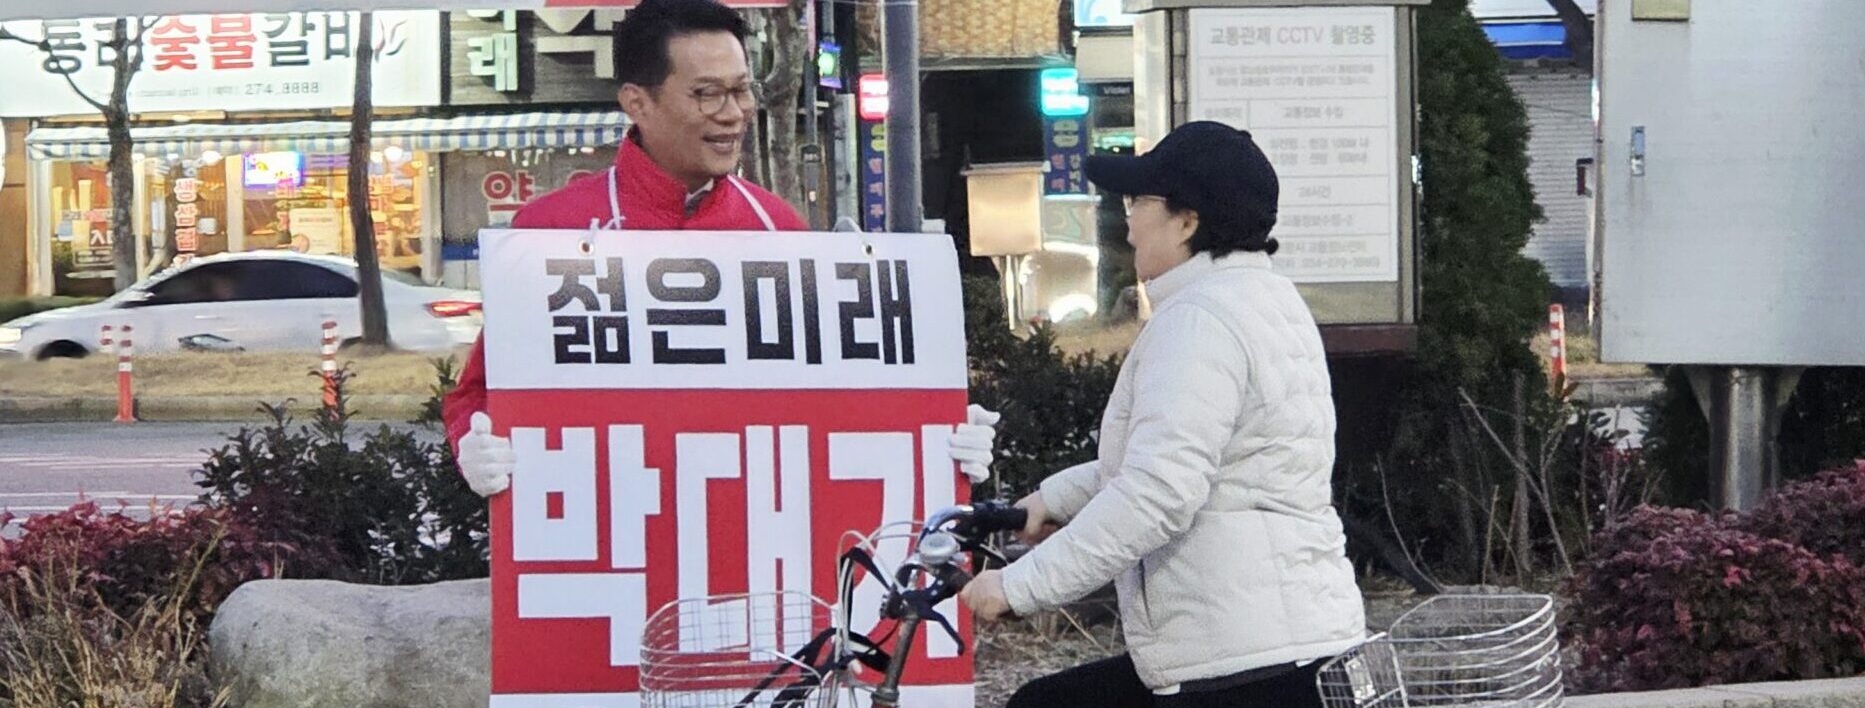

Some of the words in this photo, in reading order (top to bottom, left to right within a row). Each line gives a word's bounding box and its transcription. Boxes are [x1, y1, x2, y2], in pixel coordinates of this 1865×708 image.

[41, 13, 351, 74] 동숯불갈비
[1210, 25, 1272, 45] 교통관제
[1276, 26, 1324, 44] CCTV
[1331, 24, 1376, 45] 촬영중
[545, 256, 915, 365] 젊은미래
[511, 423, 963, 667] 박대기
